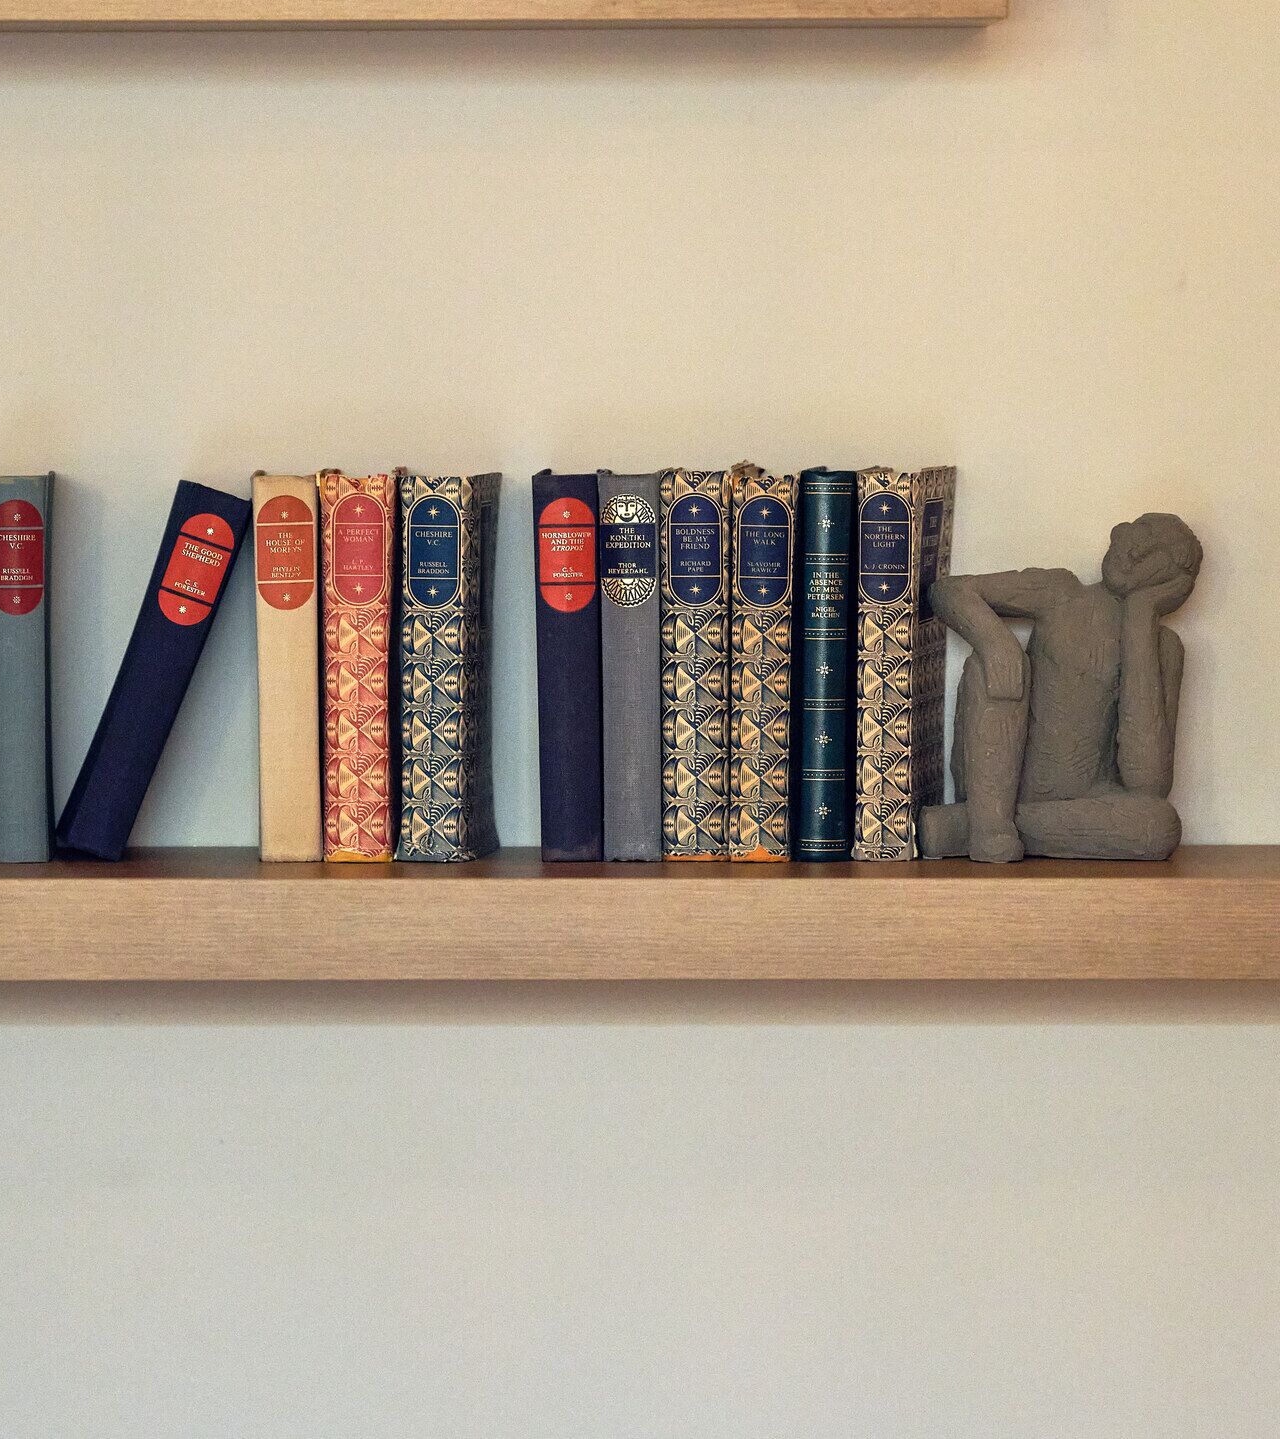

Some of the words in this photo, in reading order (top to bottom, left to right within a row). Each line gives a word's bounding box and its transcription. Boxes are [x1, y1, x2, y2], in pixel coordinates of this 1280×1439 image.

[676, 528, 715, 536] BOLDNESS
[266, 539, 292, 547] HOUSE
[343, 535, 374, 543] WOMAN
[606, 541, 651, 549] EXPEDITION
[184, 542, 199, 552] THE
[201, 548, 223, 561] GOOD
[182, 549, 221, 567] SHEPHERD
[0, 574, 33, 582] BRADDON
[174, 582, 206, 596] FORESTER
